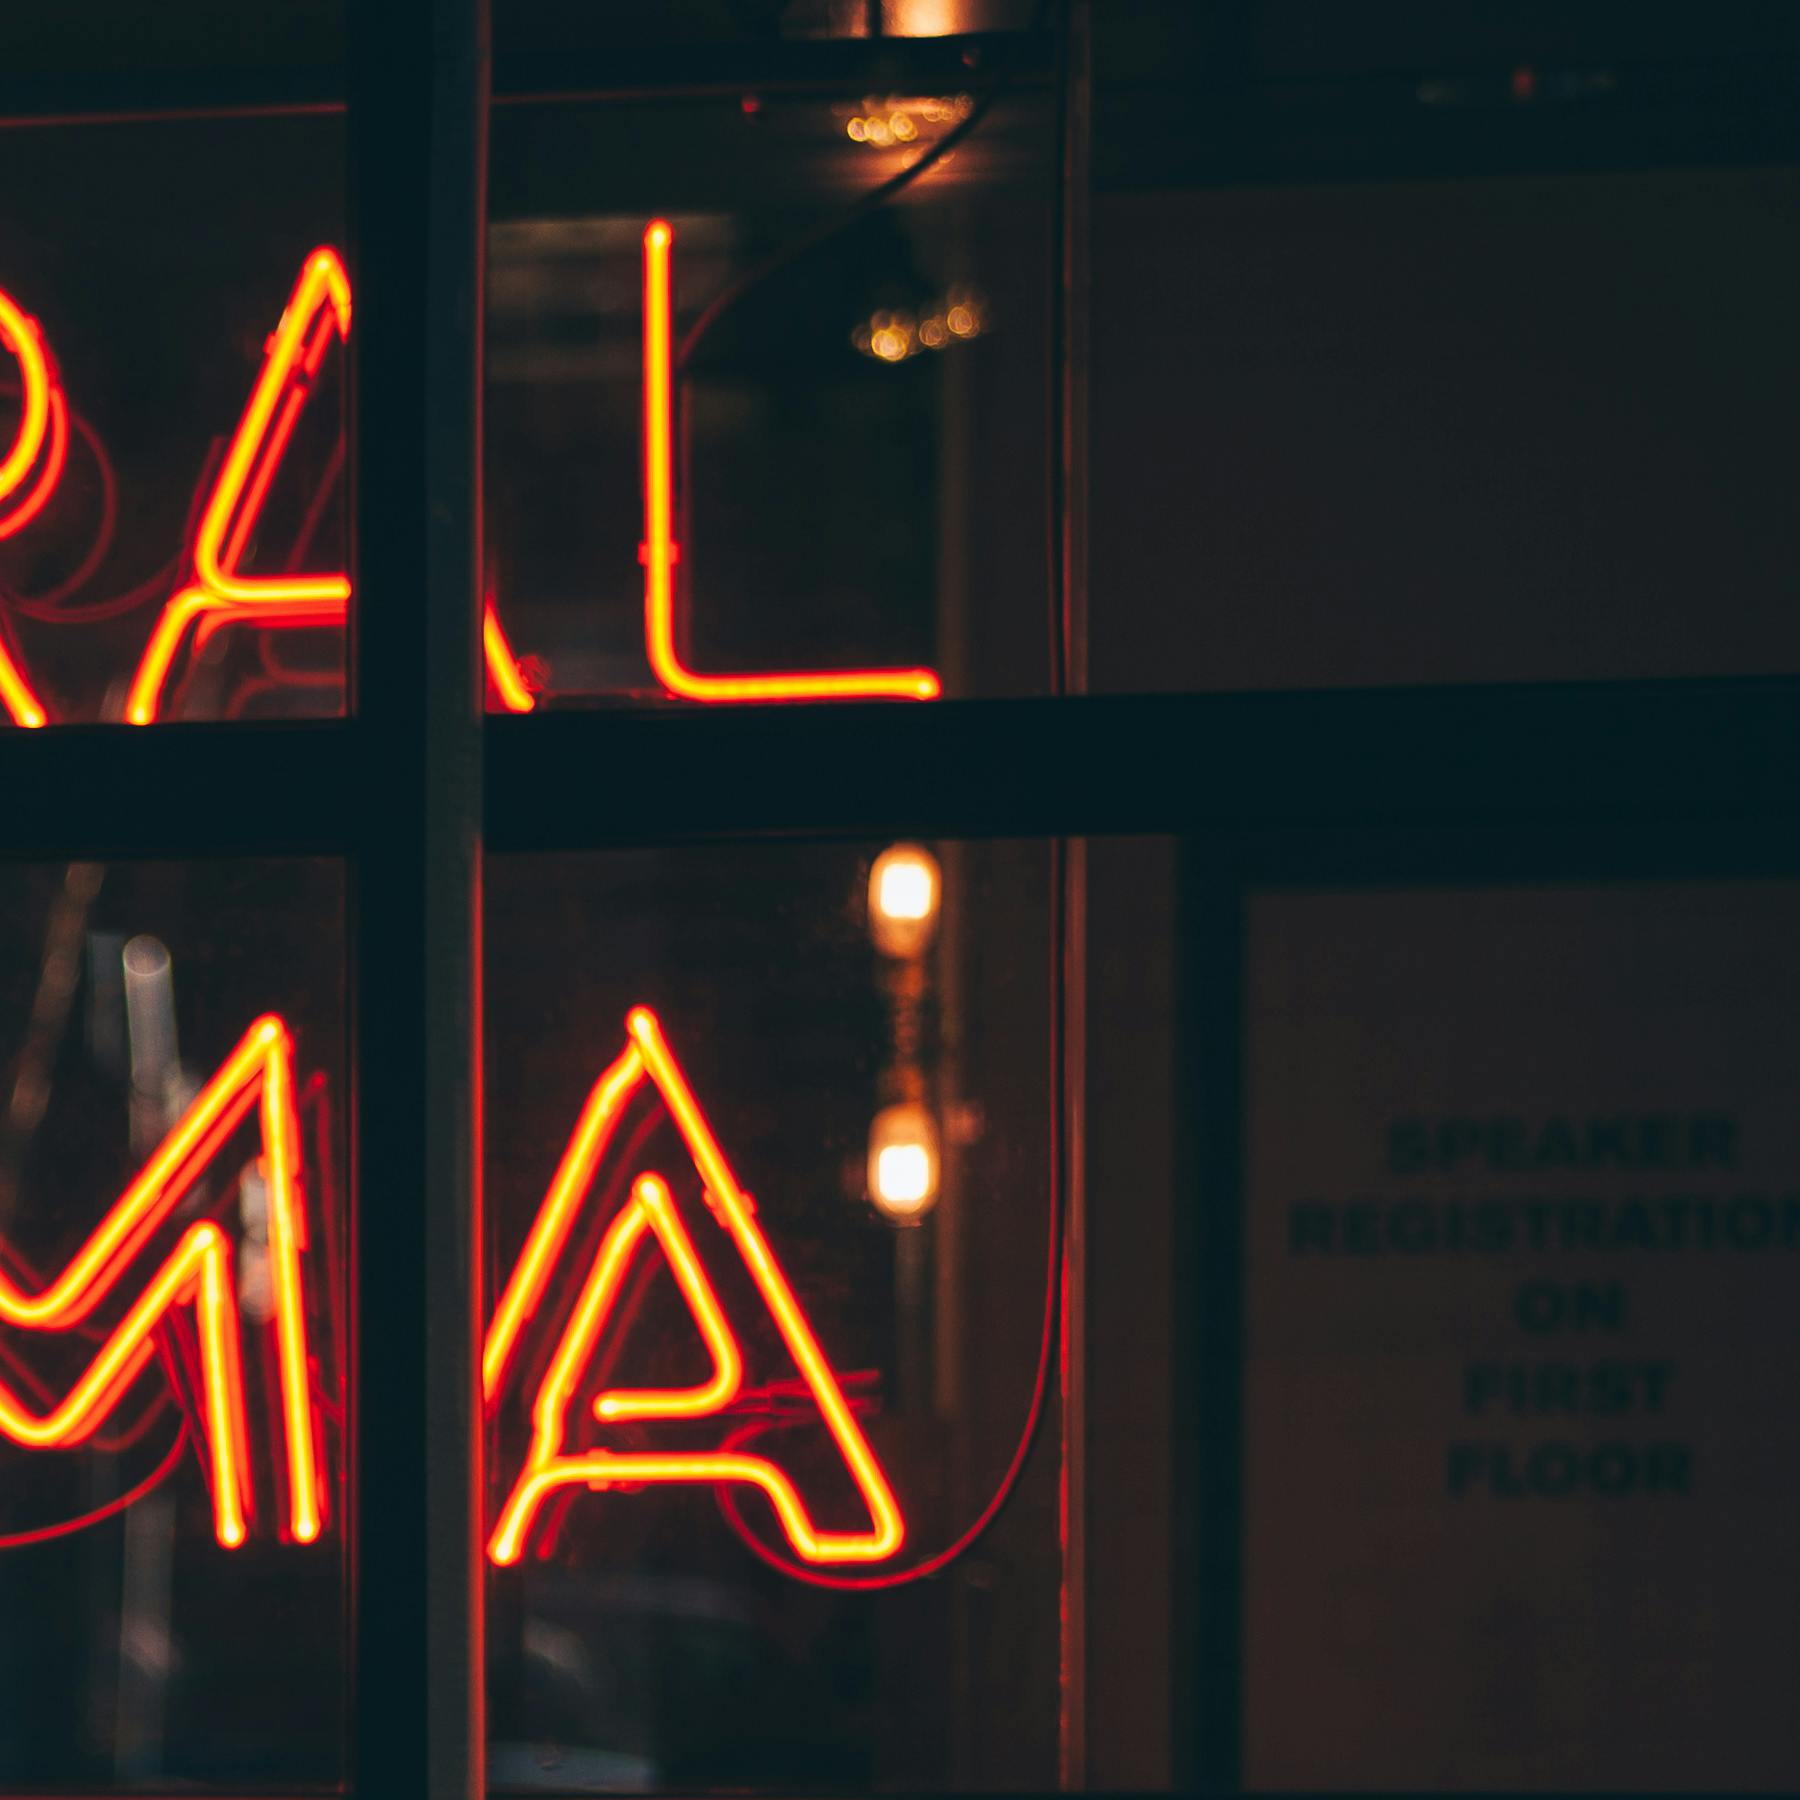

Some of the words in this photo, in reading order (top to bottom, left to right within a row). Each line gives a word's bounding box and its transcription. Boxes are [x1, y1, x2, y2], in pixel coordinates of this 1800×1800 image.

[1388, 1112, 1738, 1174] SPEAKER
[1514, 1280, 1629, 1334] ON
[1464, 1358, 1676, 1414] FIRST
[1446, 1442, 1694, 1497] FLOOR
